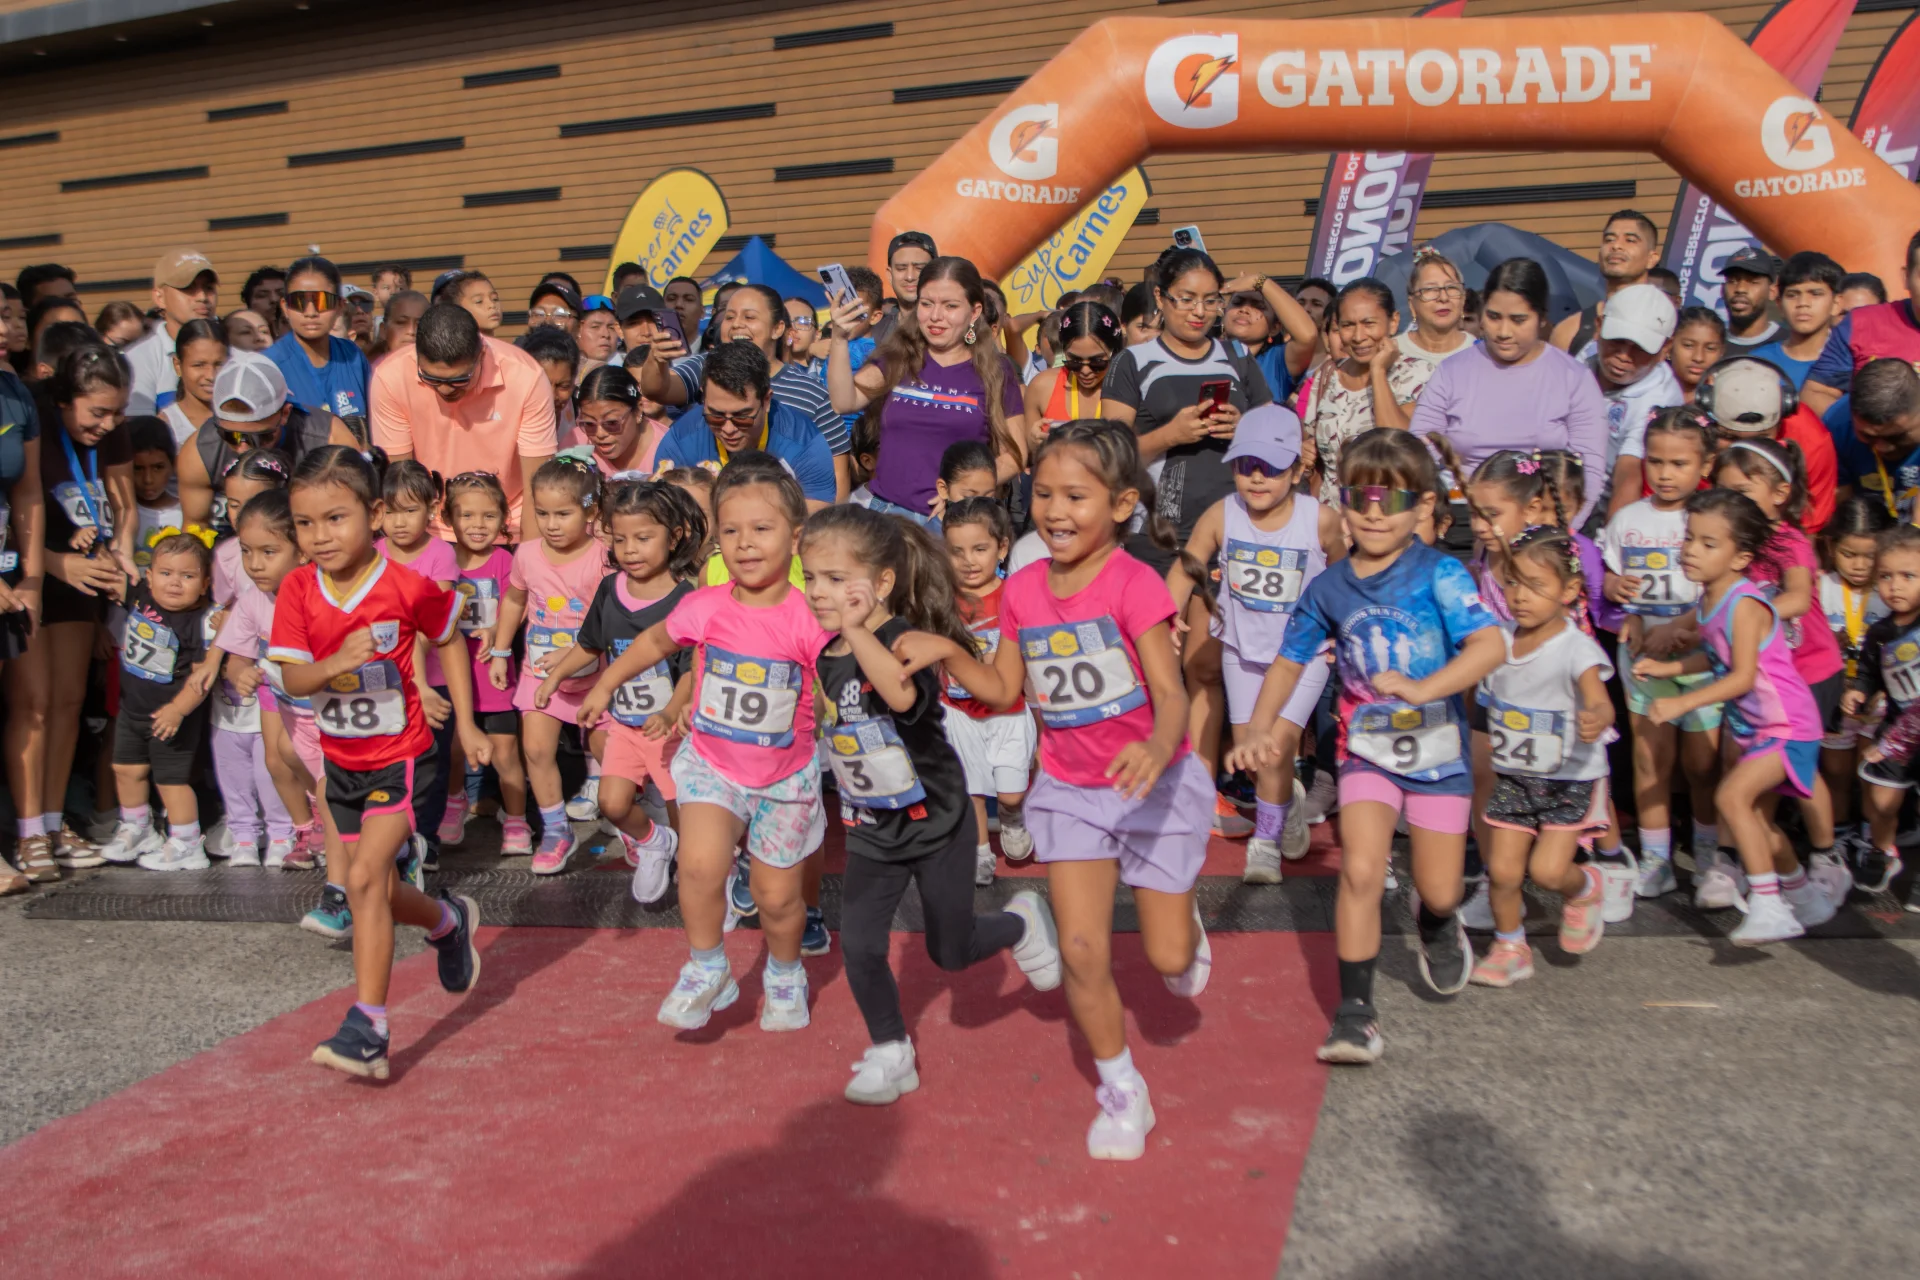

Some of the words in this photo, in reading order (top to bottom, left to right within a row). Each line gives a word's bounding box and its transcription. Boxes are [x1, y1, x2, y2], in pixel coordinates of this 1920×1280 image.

[1257, 44, 1652, 108] GATORADE
[956, 179, 1081, 204] GATORADE
[1734, 168, 1867, 198] GATORADE
[1055, 184, 1128, 281] Carnes
[649, 208, 713, 289] Carnes
[910, 381, 968, 396] TOMM
[892, 396, 973, 414] HILFIGER
[1241, 568, 1285, 598] 28
[1641, 573, 1672, 601] 21
[1369, 608, 1390, 616] RUN
[127, 634, 157, 666] 37
[616, 684, 656, 711] 45
[1043, 661, 1105, 705] 20
[321, 697, 381, 731] 48
[721, 686, 768, 726] 19
[1101, 703, 1121, 718] 20
[757, 735, 771, 747] 19
[1392, 735, 1421, 770] 9
[1492, 729, 1538, 766] 24
[842, 760, 874, 792] 3
